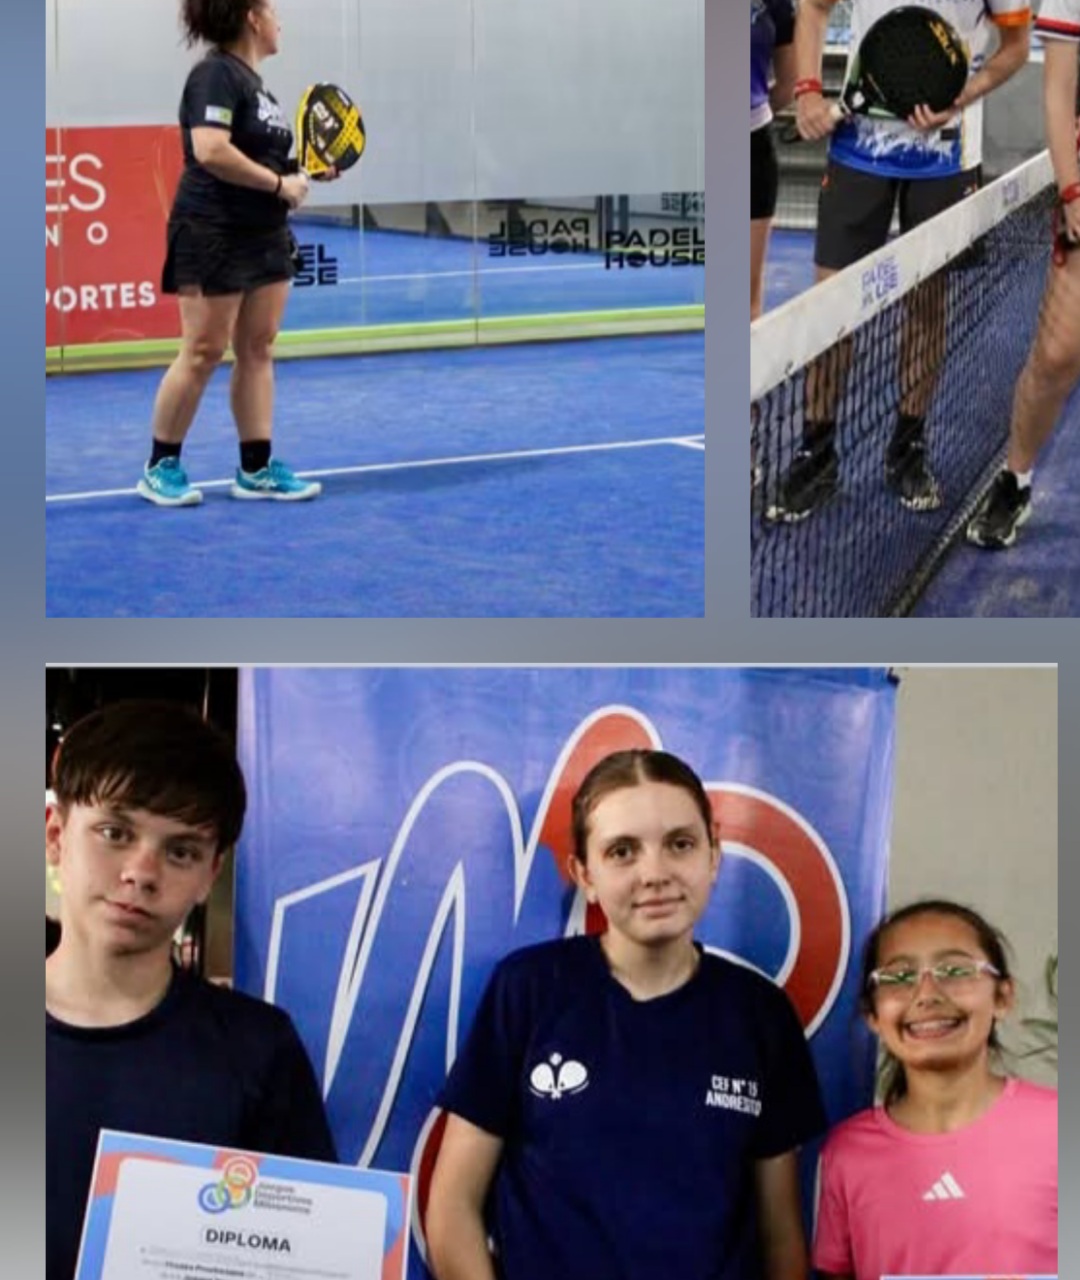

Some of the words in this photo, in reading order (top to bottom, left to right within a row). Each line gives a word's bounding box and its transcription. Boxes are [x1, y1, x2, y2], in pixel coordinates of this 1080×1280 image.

[605, 227, 705, 247] PADEL
[605, 247, 705, 270] HOUSE
[46, 280, 156, 313] ORTES
[205, 1228, 291, 1253] DIPLOMA
